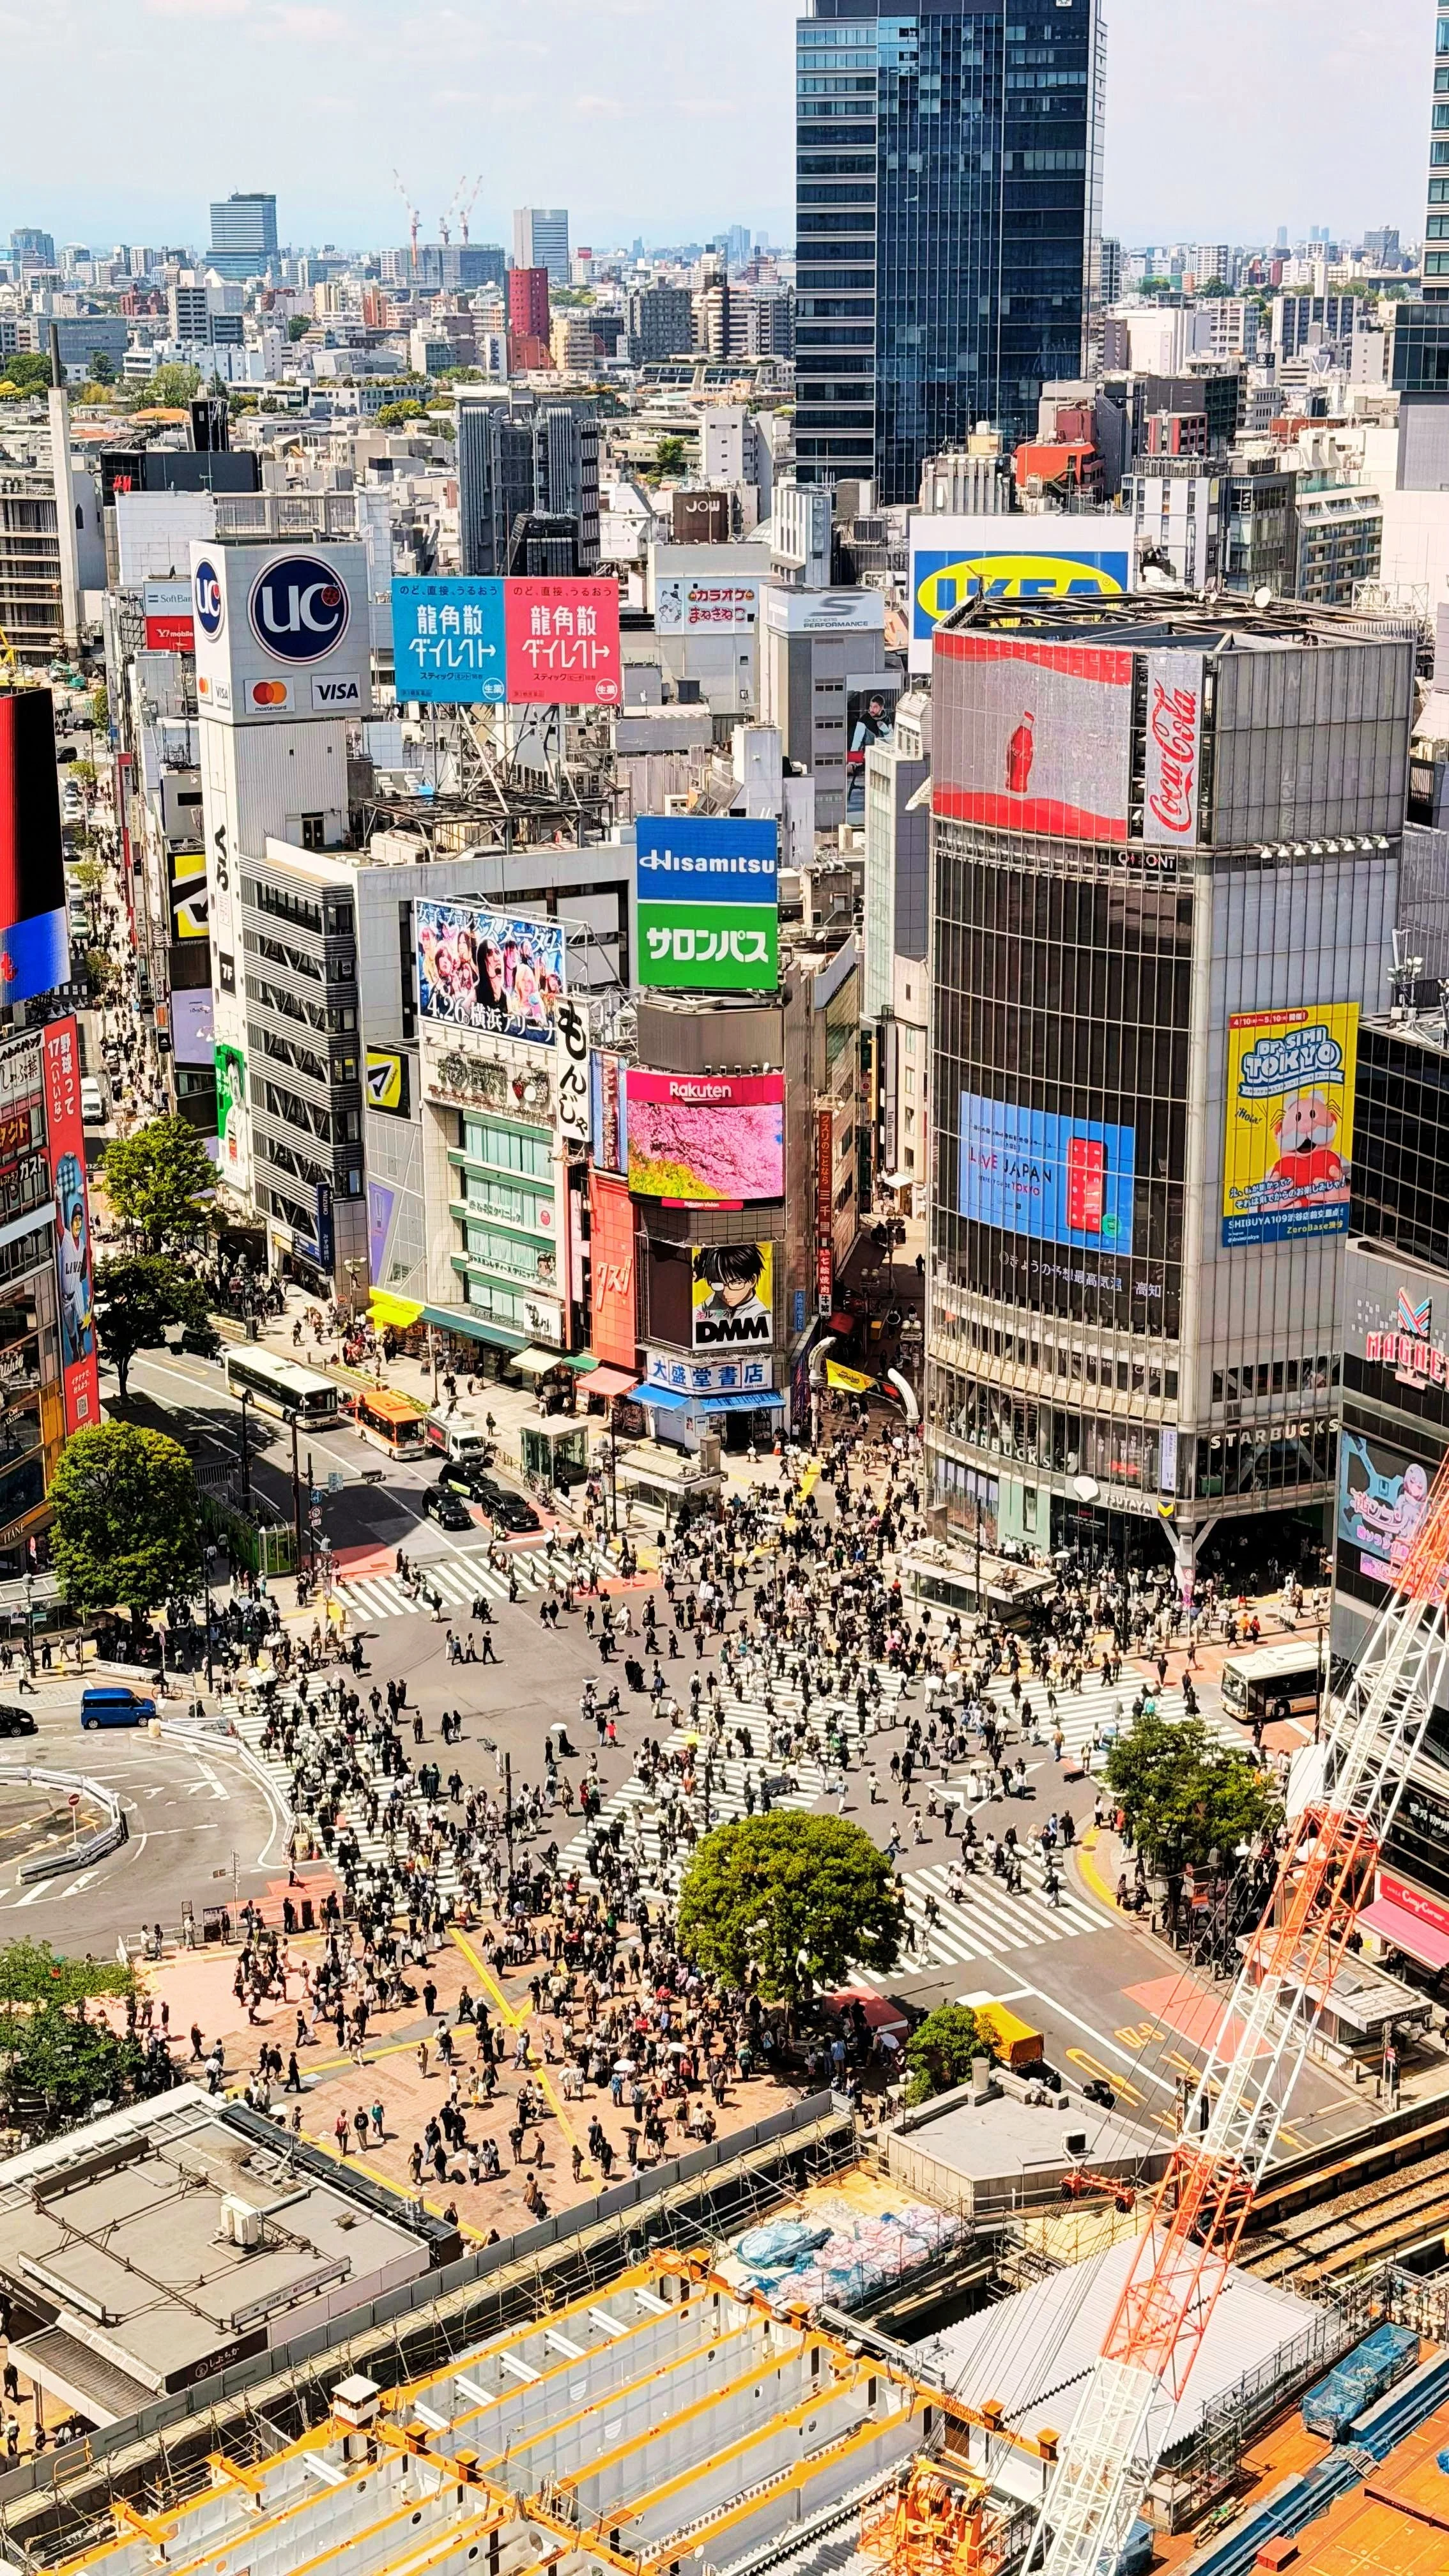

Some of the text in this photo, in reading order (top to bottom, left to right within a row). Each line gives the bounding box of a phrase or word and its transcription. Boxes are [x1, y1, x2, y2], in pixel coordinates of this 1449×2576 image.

[686, 500, 719, 512] JOW
[401, 585, 498, 595] のど、直接、うるおう
[514, 586, 611, 596] のど、直接、うるおう
[696, 590, 746, 602] カラオケ
[417, 604, 483, 635] 龍角散
[530, 605, 597, 636] 龍角散
[688, 606, 746, 624] まねきねこ
[409, 639, 496, 668] ダイレクト
[522, 640, 610, 669] ダイレクト
[420, 672, 454, 680] スティック
[533, 673, 567, 681] スティック
[216, 687, 228, 700] VISA
[316, 684, 358, 700] VISA
[1150, 678, 1196, 832] Coca-Cola
[639, 850, 776, 876] Hisamitsu
[1118, 852, 1176, 870] QONT
[646, 929, 768, 963] サロンパス
[222, 963, 233, 981] 7F
[427, 994, 464, 1024] 4.26
[471, 1002, 556, 1041] 横浜アリーナ
[1259, 1027, 1323, 1054] Dr. SIMI
[558, 1000, 588, 1137] もんじゃ
[1246, 1042, 1336, 1080] TOKYO
[670, 1081, 732, 1098] Rakuten
[821, 1116, 830, 1184] クスリのことなら
[20, 1154, 45, 1181] ガスト
[970, 1147, 1052, 1183] LVE JAPAN
[1135, 1282, 1162, 1298] 高知
[696, 1317, 769, 1344] DMM
[1061, 1349, 1084, 1361] Tme
[654, 1360, 763, 1387] 大盛堂書店
[949, 1420, 1051, 1468] STARBUCKS
[1211, 1418, 1340, 1450] STARBUCKS
[1104, 1494, 1151, 1512] TSUTAYA
[210, 2347, 240, 2368] しぶちか
